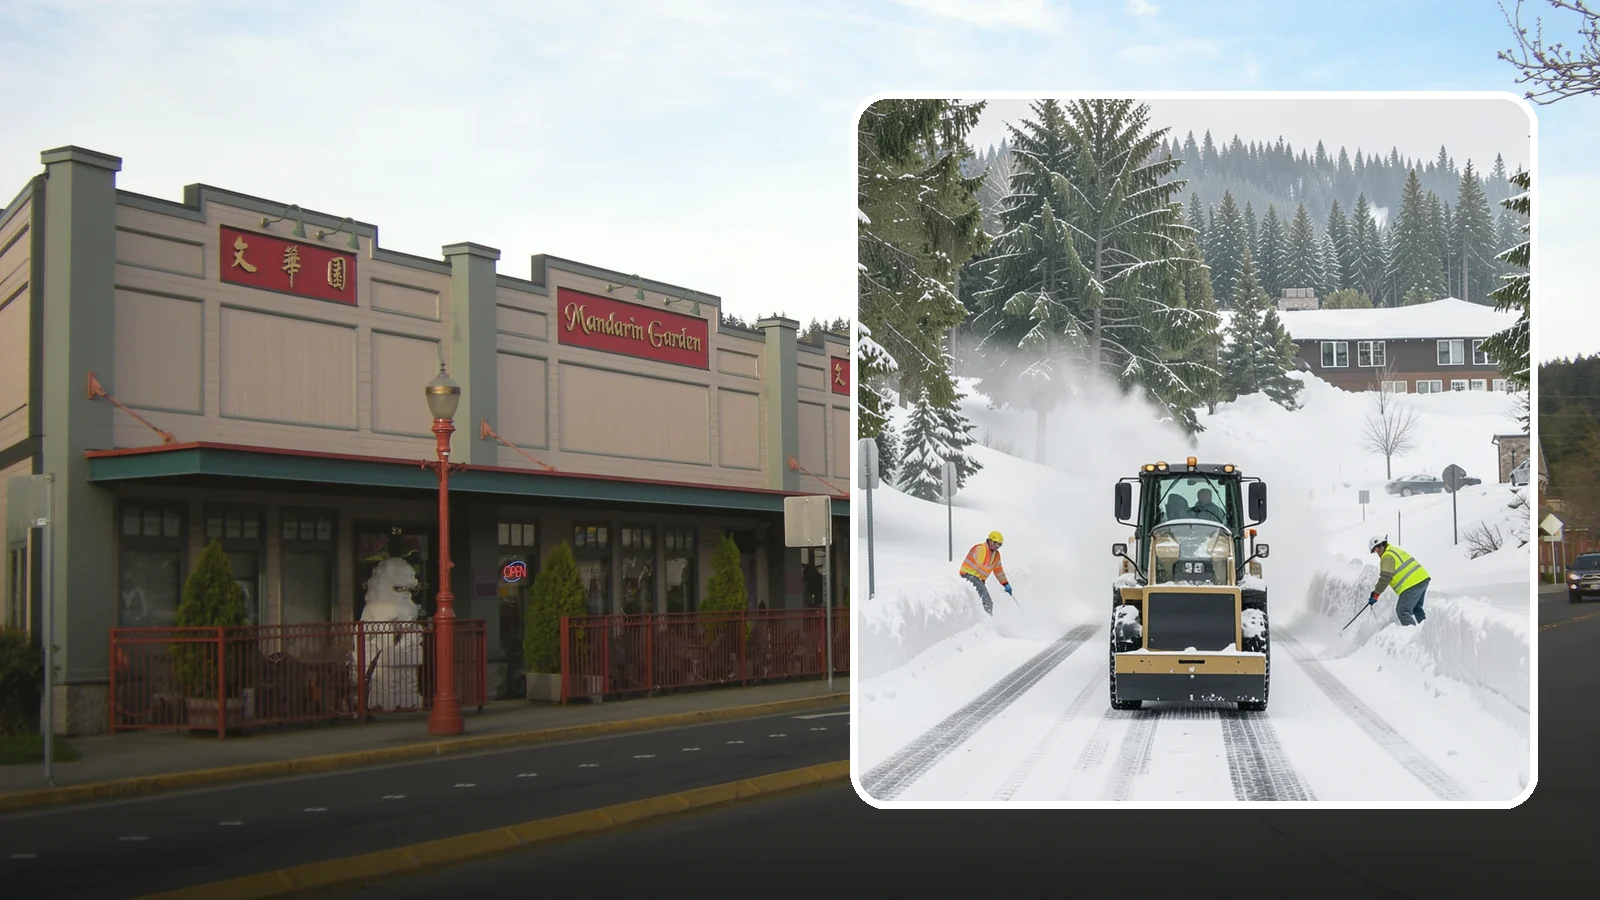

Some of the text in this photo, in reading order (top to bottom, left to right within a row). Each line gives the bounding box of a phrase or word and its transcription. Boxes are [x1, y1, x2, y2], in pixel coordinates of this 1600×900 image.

[231, 236, 346, 291] 文華園
[565, 302, 701, 352] Mandarin Garden
[503, 565, 527, 578] OPEN
